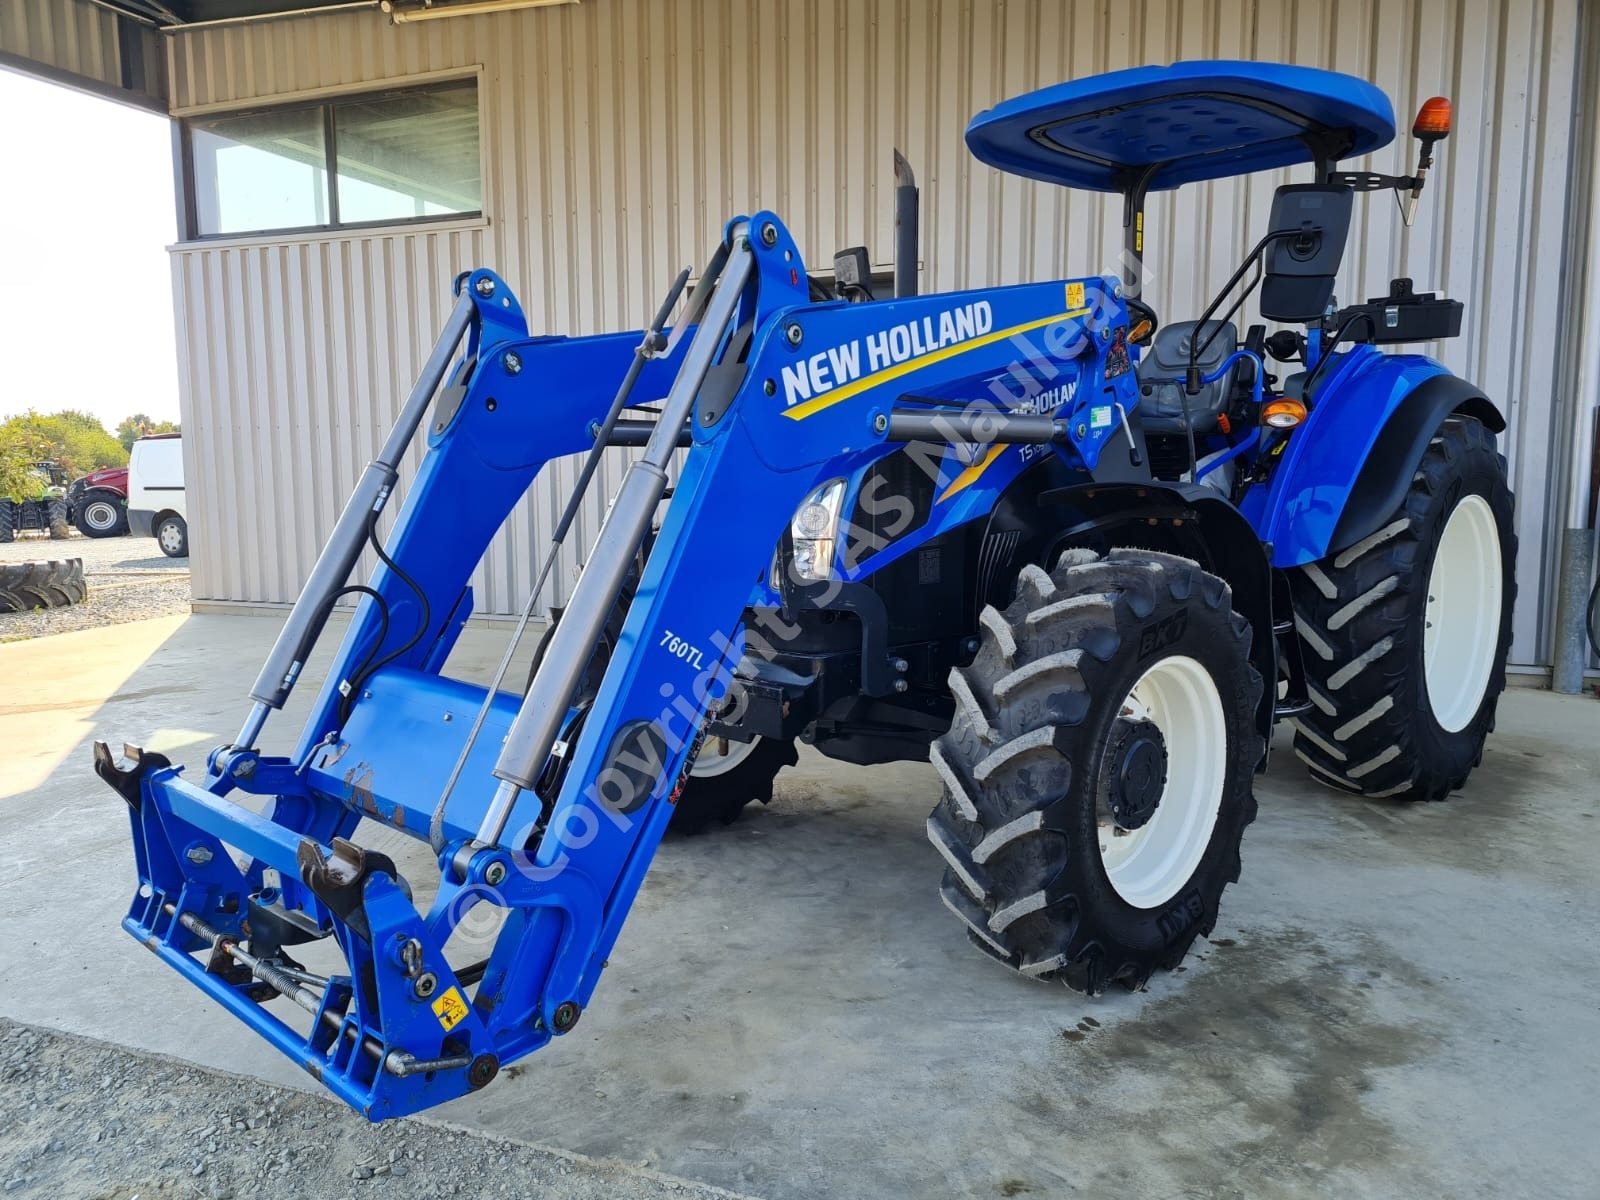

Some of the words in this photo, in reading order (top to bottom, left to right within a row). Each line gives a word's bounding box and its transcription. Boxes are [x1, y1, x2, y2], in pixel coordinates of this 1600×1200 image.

[781, 339, 860, 406] NEW
[866, 300, 993, 371] HOLLAND
[1030, 382, 1077, 415] HOLLAN
[660, 630, 703, 670] 760TL
